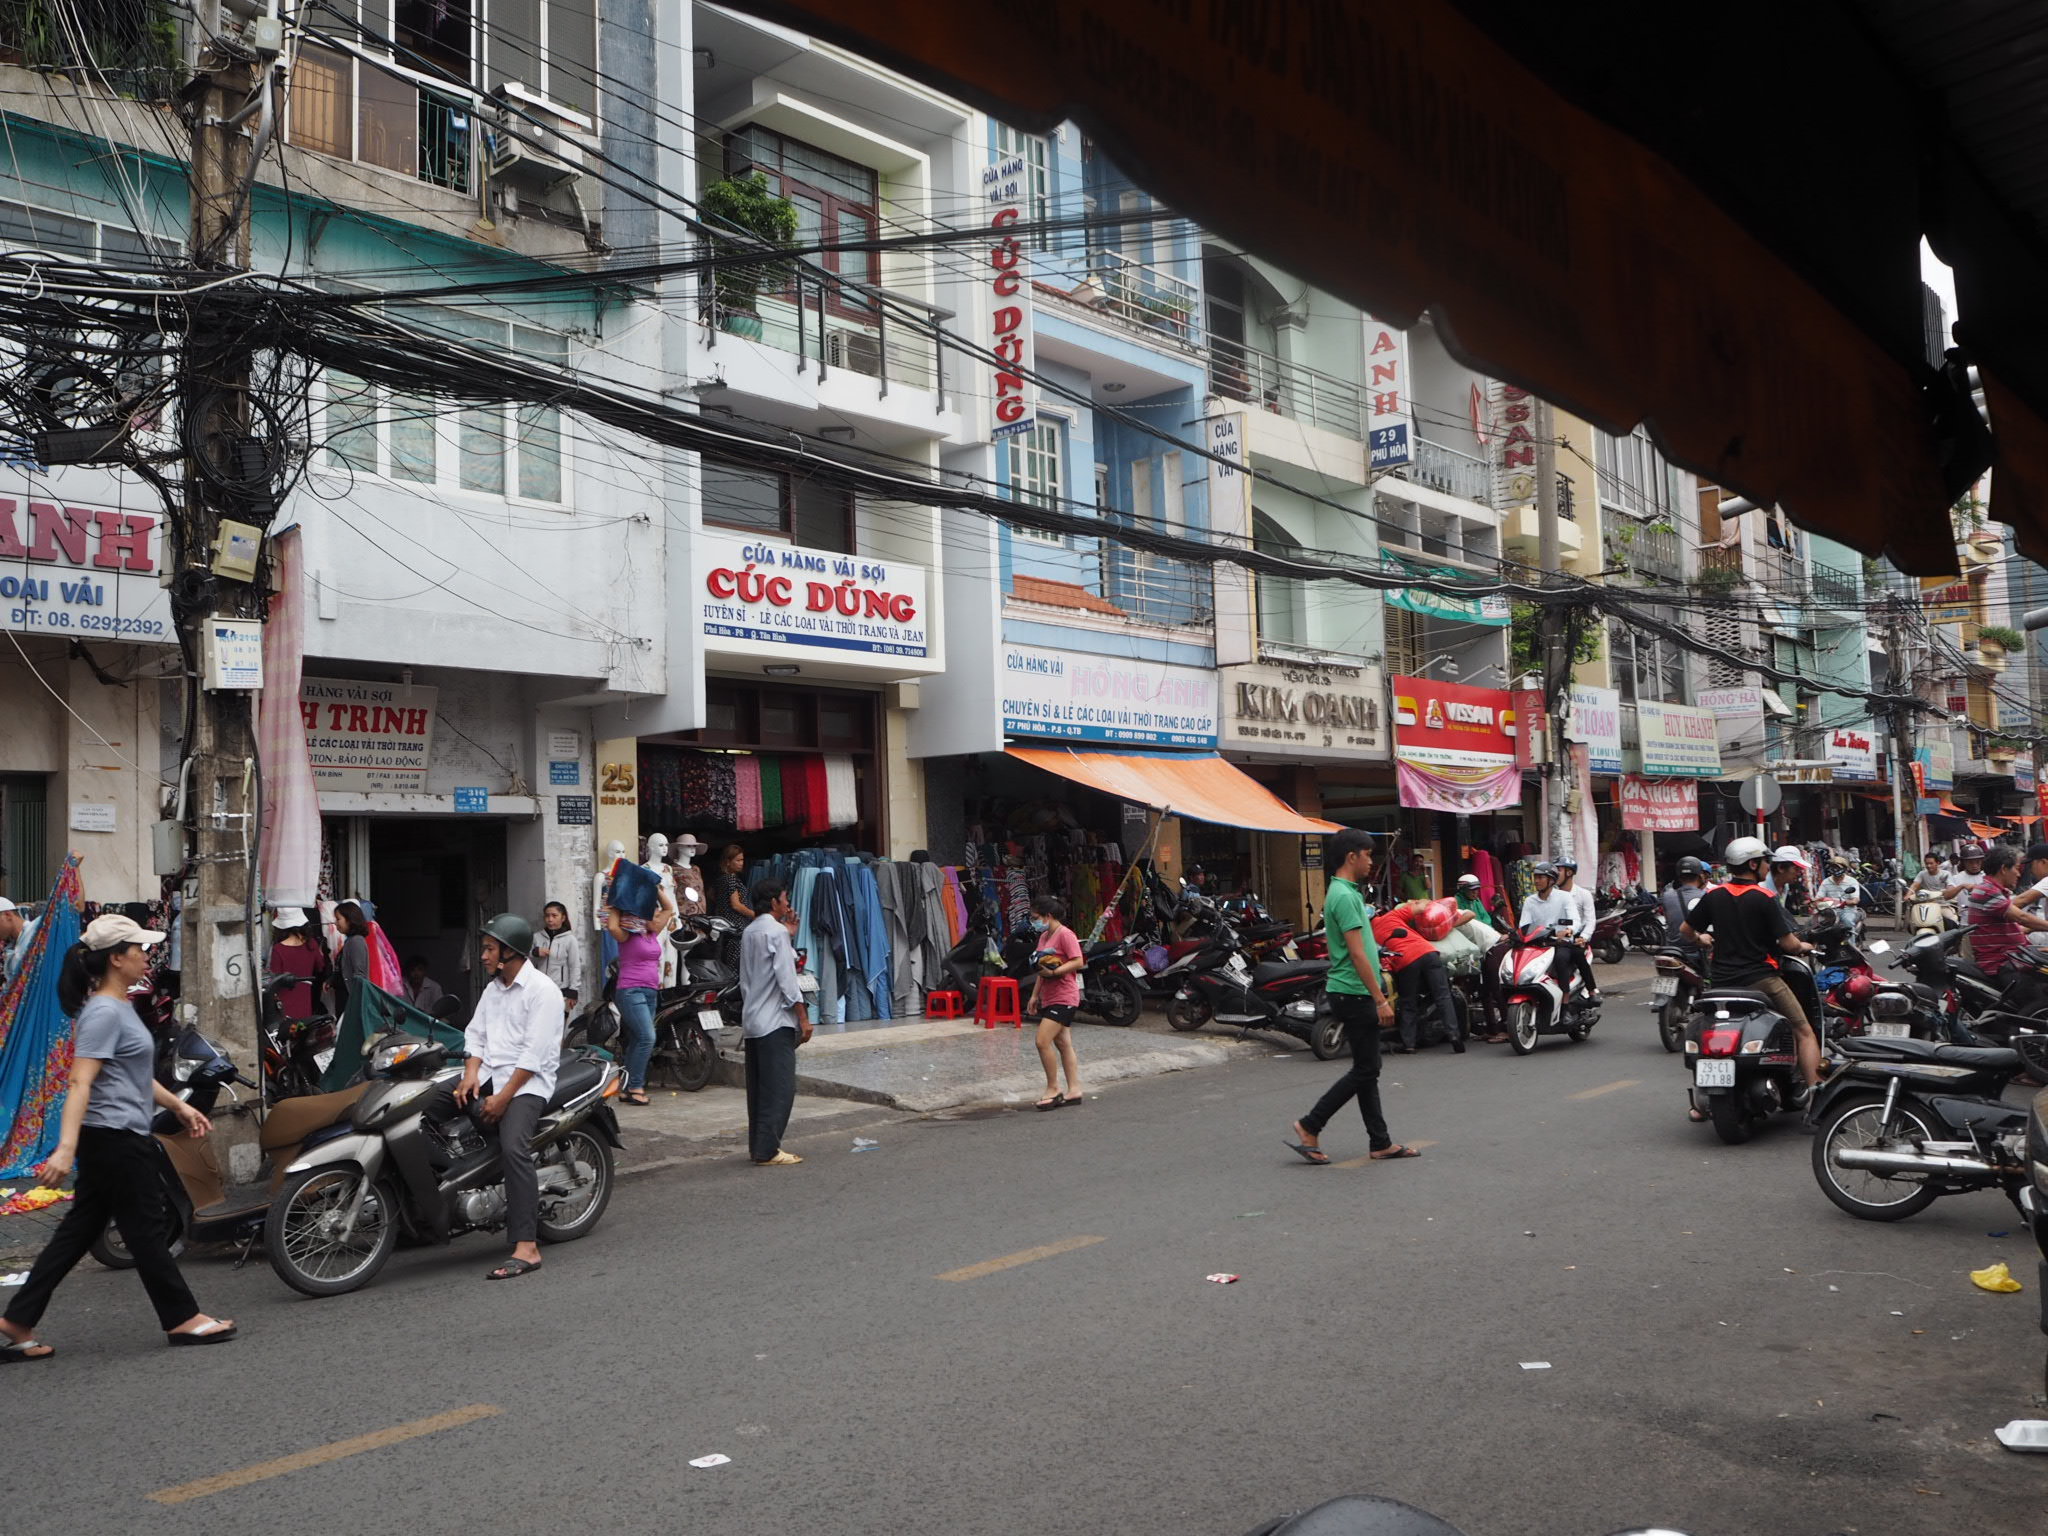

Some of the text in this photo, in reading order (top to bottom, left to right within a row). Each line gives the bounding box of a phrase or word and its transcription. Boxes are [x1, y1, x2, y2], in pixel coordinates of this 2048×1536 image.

[1379, 429, 1397, 444] 29
[1371, 442, 1407, 464] PHÚ HÒA
[742, 542, 886, 584] CỬA HÀNG VẢI SỢI
[61, 576, 104, 606] VẢI
[706, 563, 917, 622] CÚC DŨNG
[80, 614, 164, 635] 62922392
[774, 611, 793, 627] CÁC
[795, 615, 817, 632] LOẠI
[819, 616, 834, 632] VẢI
[836, 618, 857, 635] THỜI
[859, 623, 888, 638] TRANG
[889, 625, 900, 640] VÀ
[902, 629, 924, 643] JEAN
[1007, 649, 1064, 675] CỬA HÀNG VẢI
[305, 682, 393, 703] HÀNG VẢI SỢI
[1002, 698, 1039, 717] CHUYÊN
[1053, 706, 1061, 719] &
[1076, 703, 1095, 722] CÁC
[1098, 709, 1116, 727] LOẠI
[1117, 706, 1132, 725] VẢI
[1133, 710, 1152, 727] THỜI
[1154, 714, 1180, 730] TRANG
[1180, 717, 1196, 731] CAO
[1198, 711, 1213, 731] CẤP
[1235, 681, 1380, 731] KIM OANH
[1442, 701, 1495, 726] VISSAN
[327, 703, 428, 735] TRINH
[1006, 720, 1016, 730] 27
[1017, 721, 1030, 731] PHÚ
[1032, 722, 1047, 733] HÒA
[319, 738, 338, 749] CÁC
[340, 740, 360, 752] LOẠI
[361, 739, 376, 751] VẢI
[377, 739, 396, 751] THỜI
[398, 742, 424, 752] TRANG
[339, 753, 357, 765] BẢO
[360, 754, 374, 768] HỘ
[376, 756, 393, 766] LAO
[395, 755, 422, 768] ĐỘNG
[602, 763, 635, 792] 25
[226, 953, 243, 977] 6
